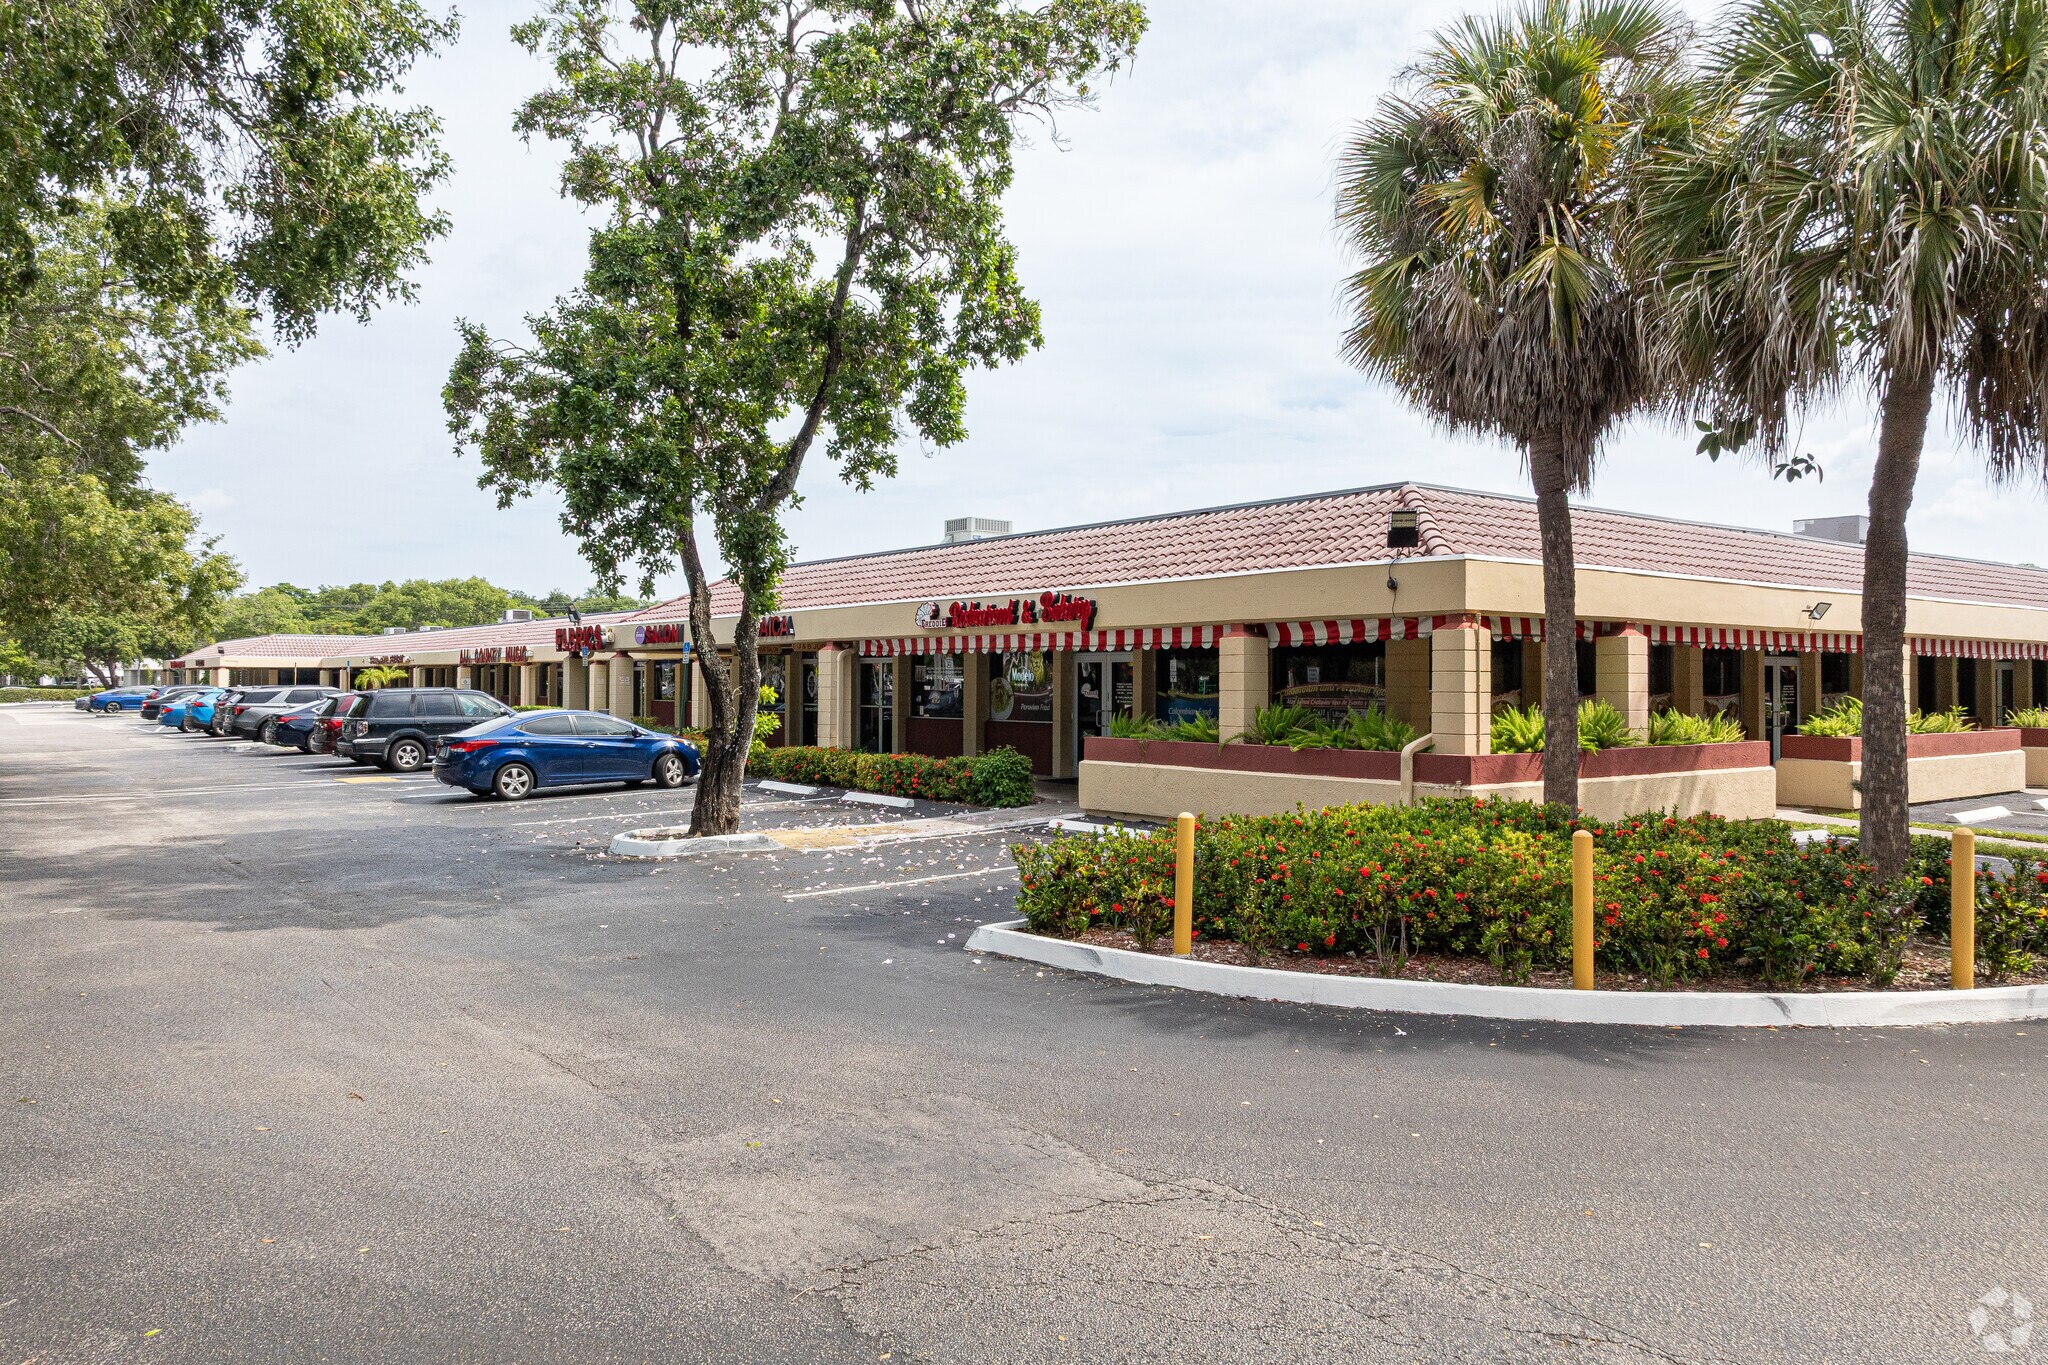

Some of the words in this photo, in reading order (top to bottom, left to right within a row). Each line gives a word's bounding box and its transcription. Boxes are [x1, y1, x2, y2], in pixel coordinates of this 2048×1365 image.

[1021, 600, 1034, 623] &
[556, 624, 603, 652] FABRICS
[645, 624, 680, 643] SALON
[460, 649, 470, 664] ALL
[475, 647, 502, 663] COUNTY
[506, 645, 528, 662] MUSIC
[1011, 667, 1034, 682] Modelo
